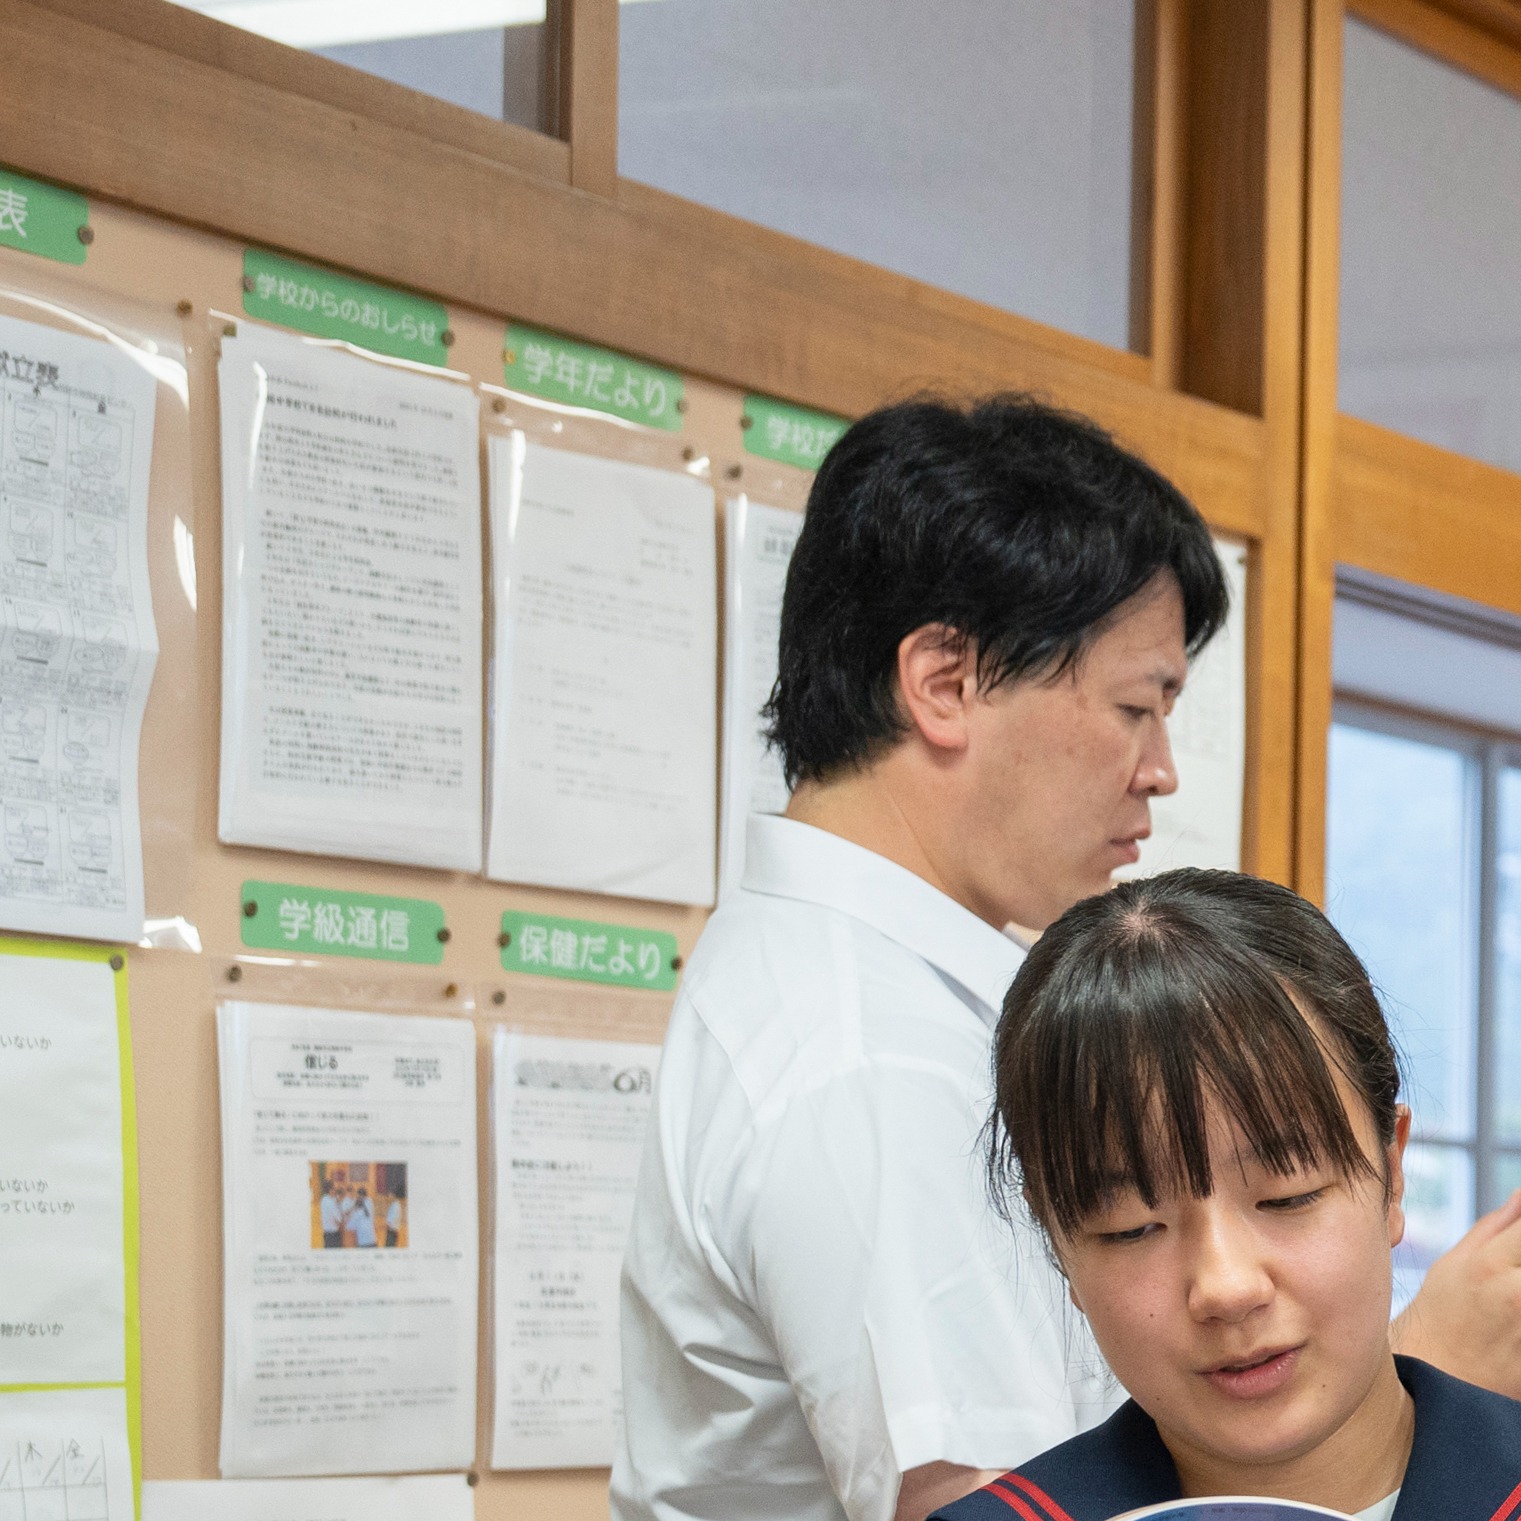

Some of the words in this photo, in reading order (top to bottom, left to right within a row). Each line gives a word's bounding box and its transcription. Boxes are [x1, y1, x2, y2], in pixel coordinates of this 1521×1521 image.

[257, 271, 437, 348] 学校からのおしらせ
[523, 343, 667, 417] 学年だより
[279, 897, 411, 953] 学級通信
[518, 923, 661, 981] 保健だより
[304, 1054, 339, 1071] 信じる
